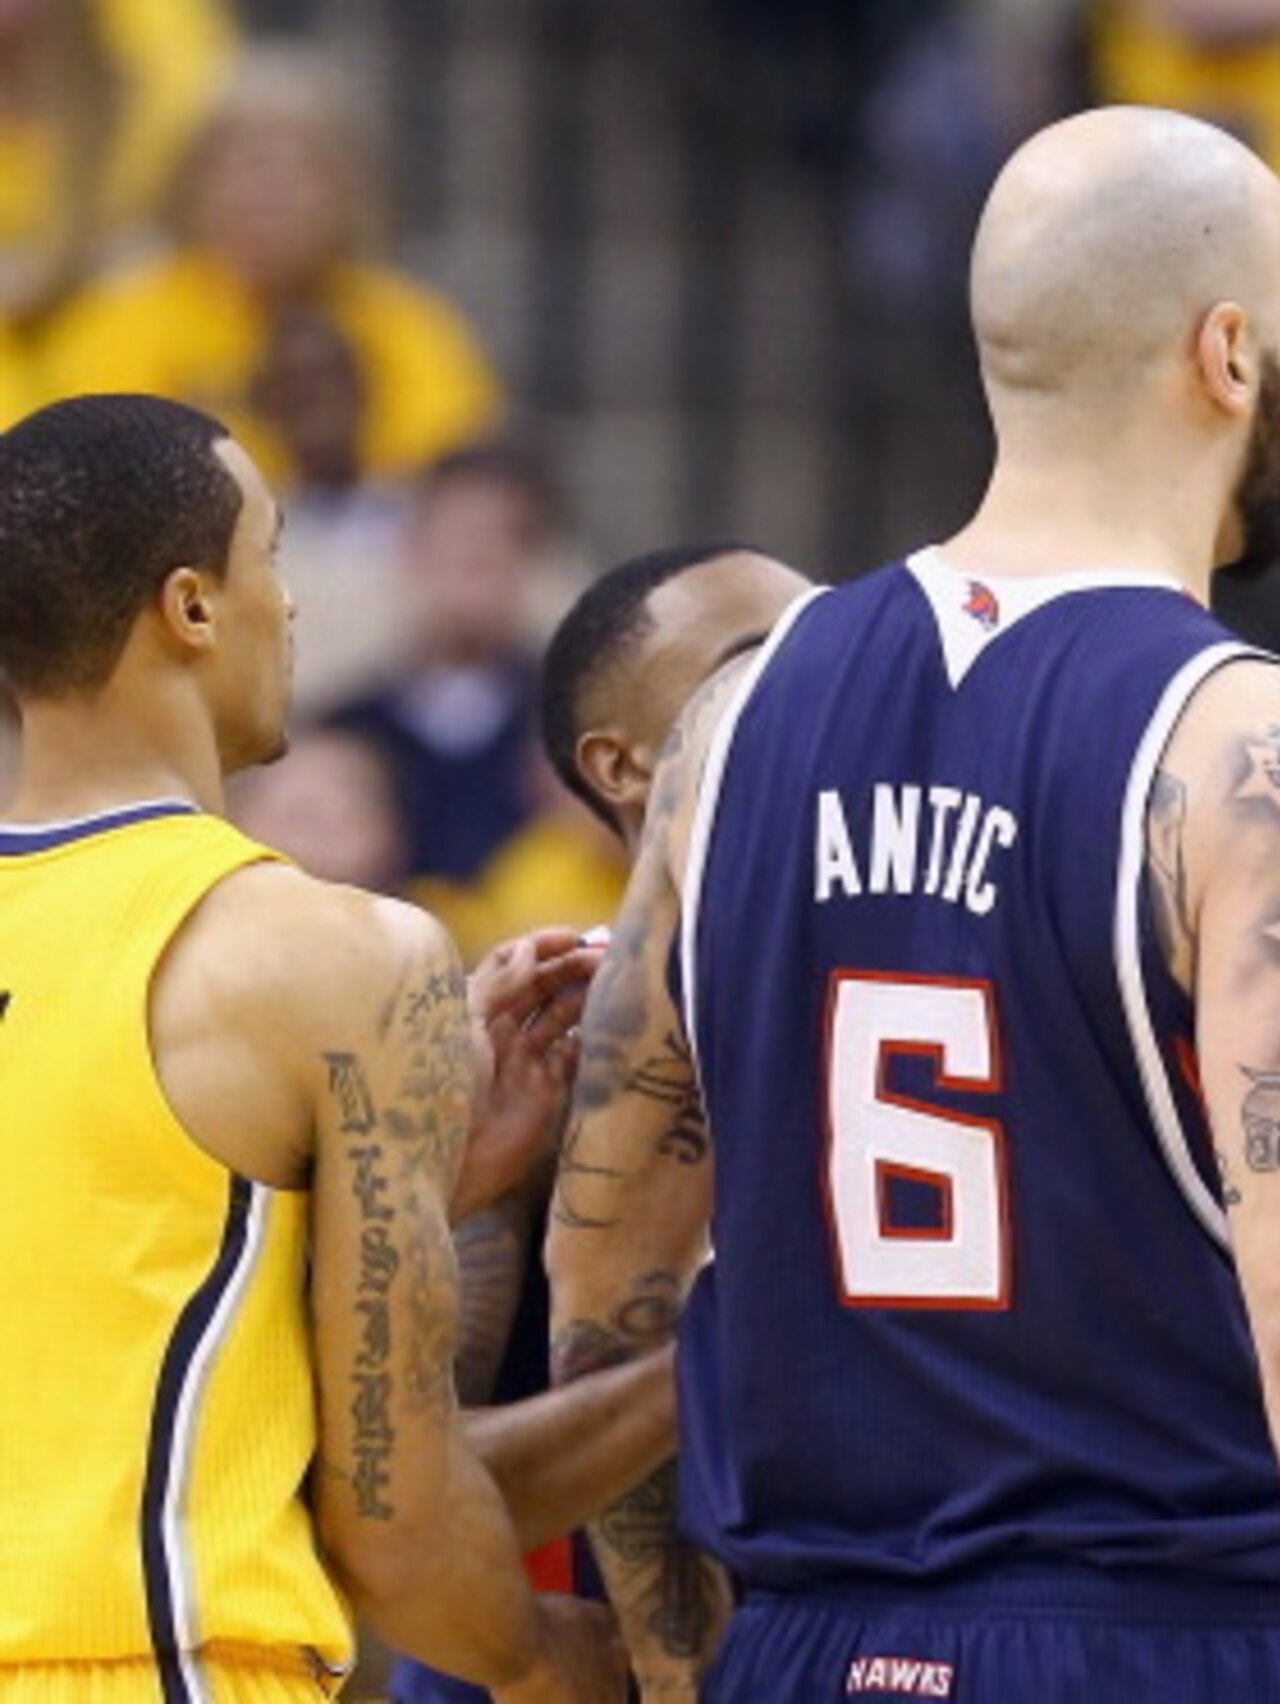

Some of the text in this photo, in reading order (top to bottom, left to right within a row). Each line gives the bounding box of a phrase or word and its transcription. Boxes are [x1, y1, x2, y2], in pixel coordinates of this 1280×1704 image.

[814, 782, 1017, 914] ANTIC
[824, 967, 1011, 1311] 6
[846, 1656, 953, 1697] HAWKS
